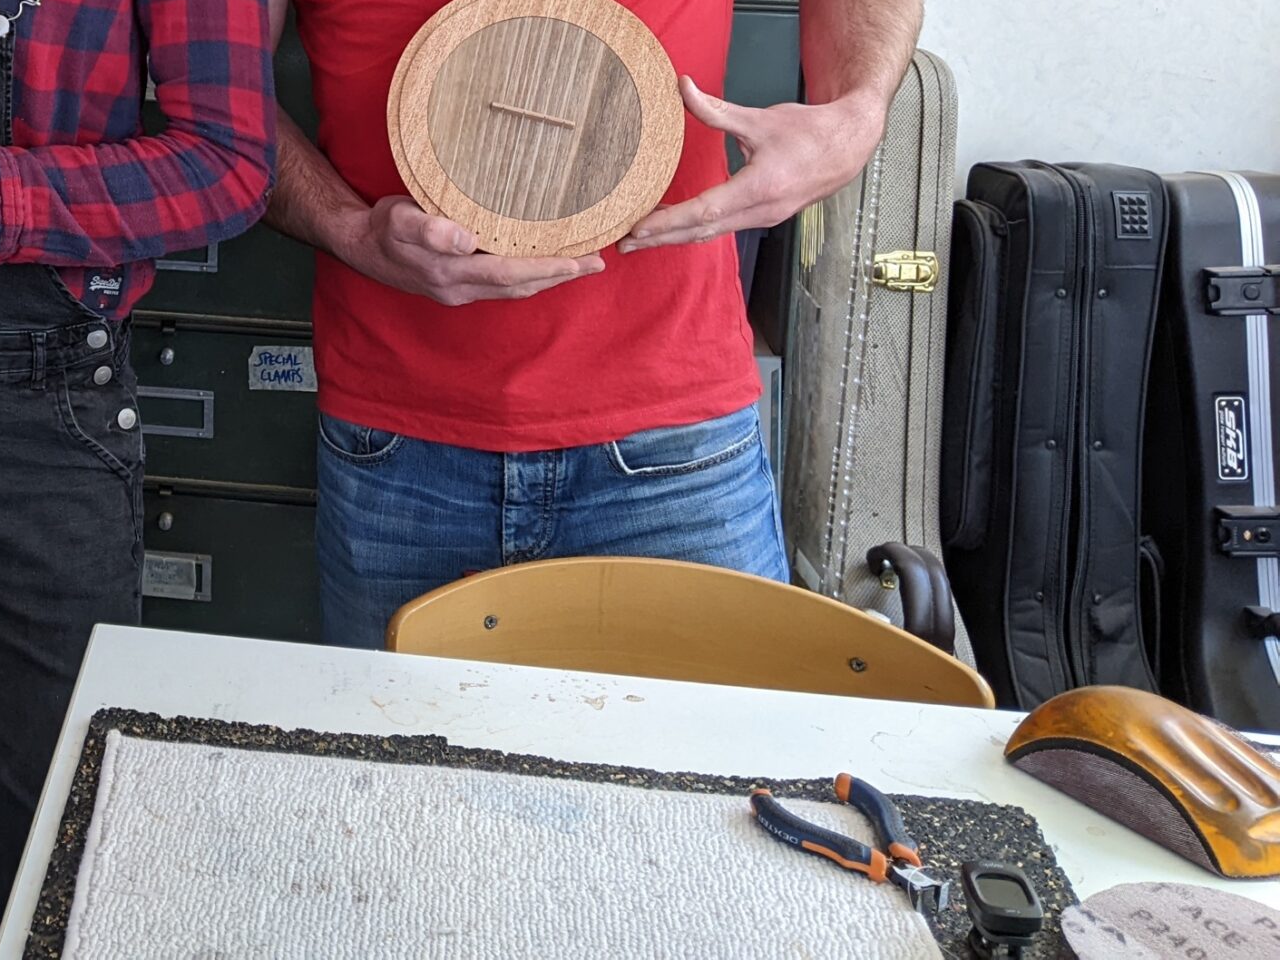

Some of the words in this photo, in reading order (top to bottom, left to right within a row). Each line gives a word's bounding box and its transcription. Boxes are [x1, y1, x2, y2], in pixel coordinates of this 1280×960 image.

[253, 351, 303, 368] SPECIAL
[261, 367, 303, 385] CLAMPS
[1224, 407, 1242, 470] SKB
[757, 813, 800, 845] DEXTER
